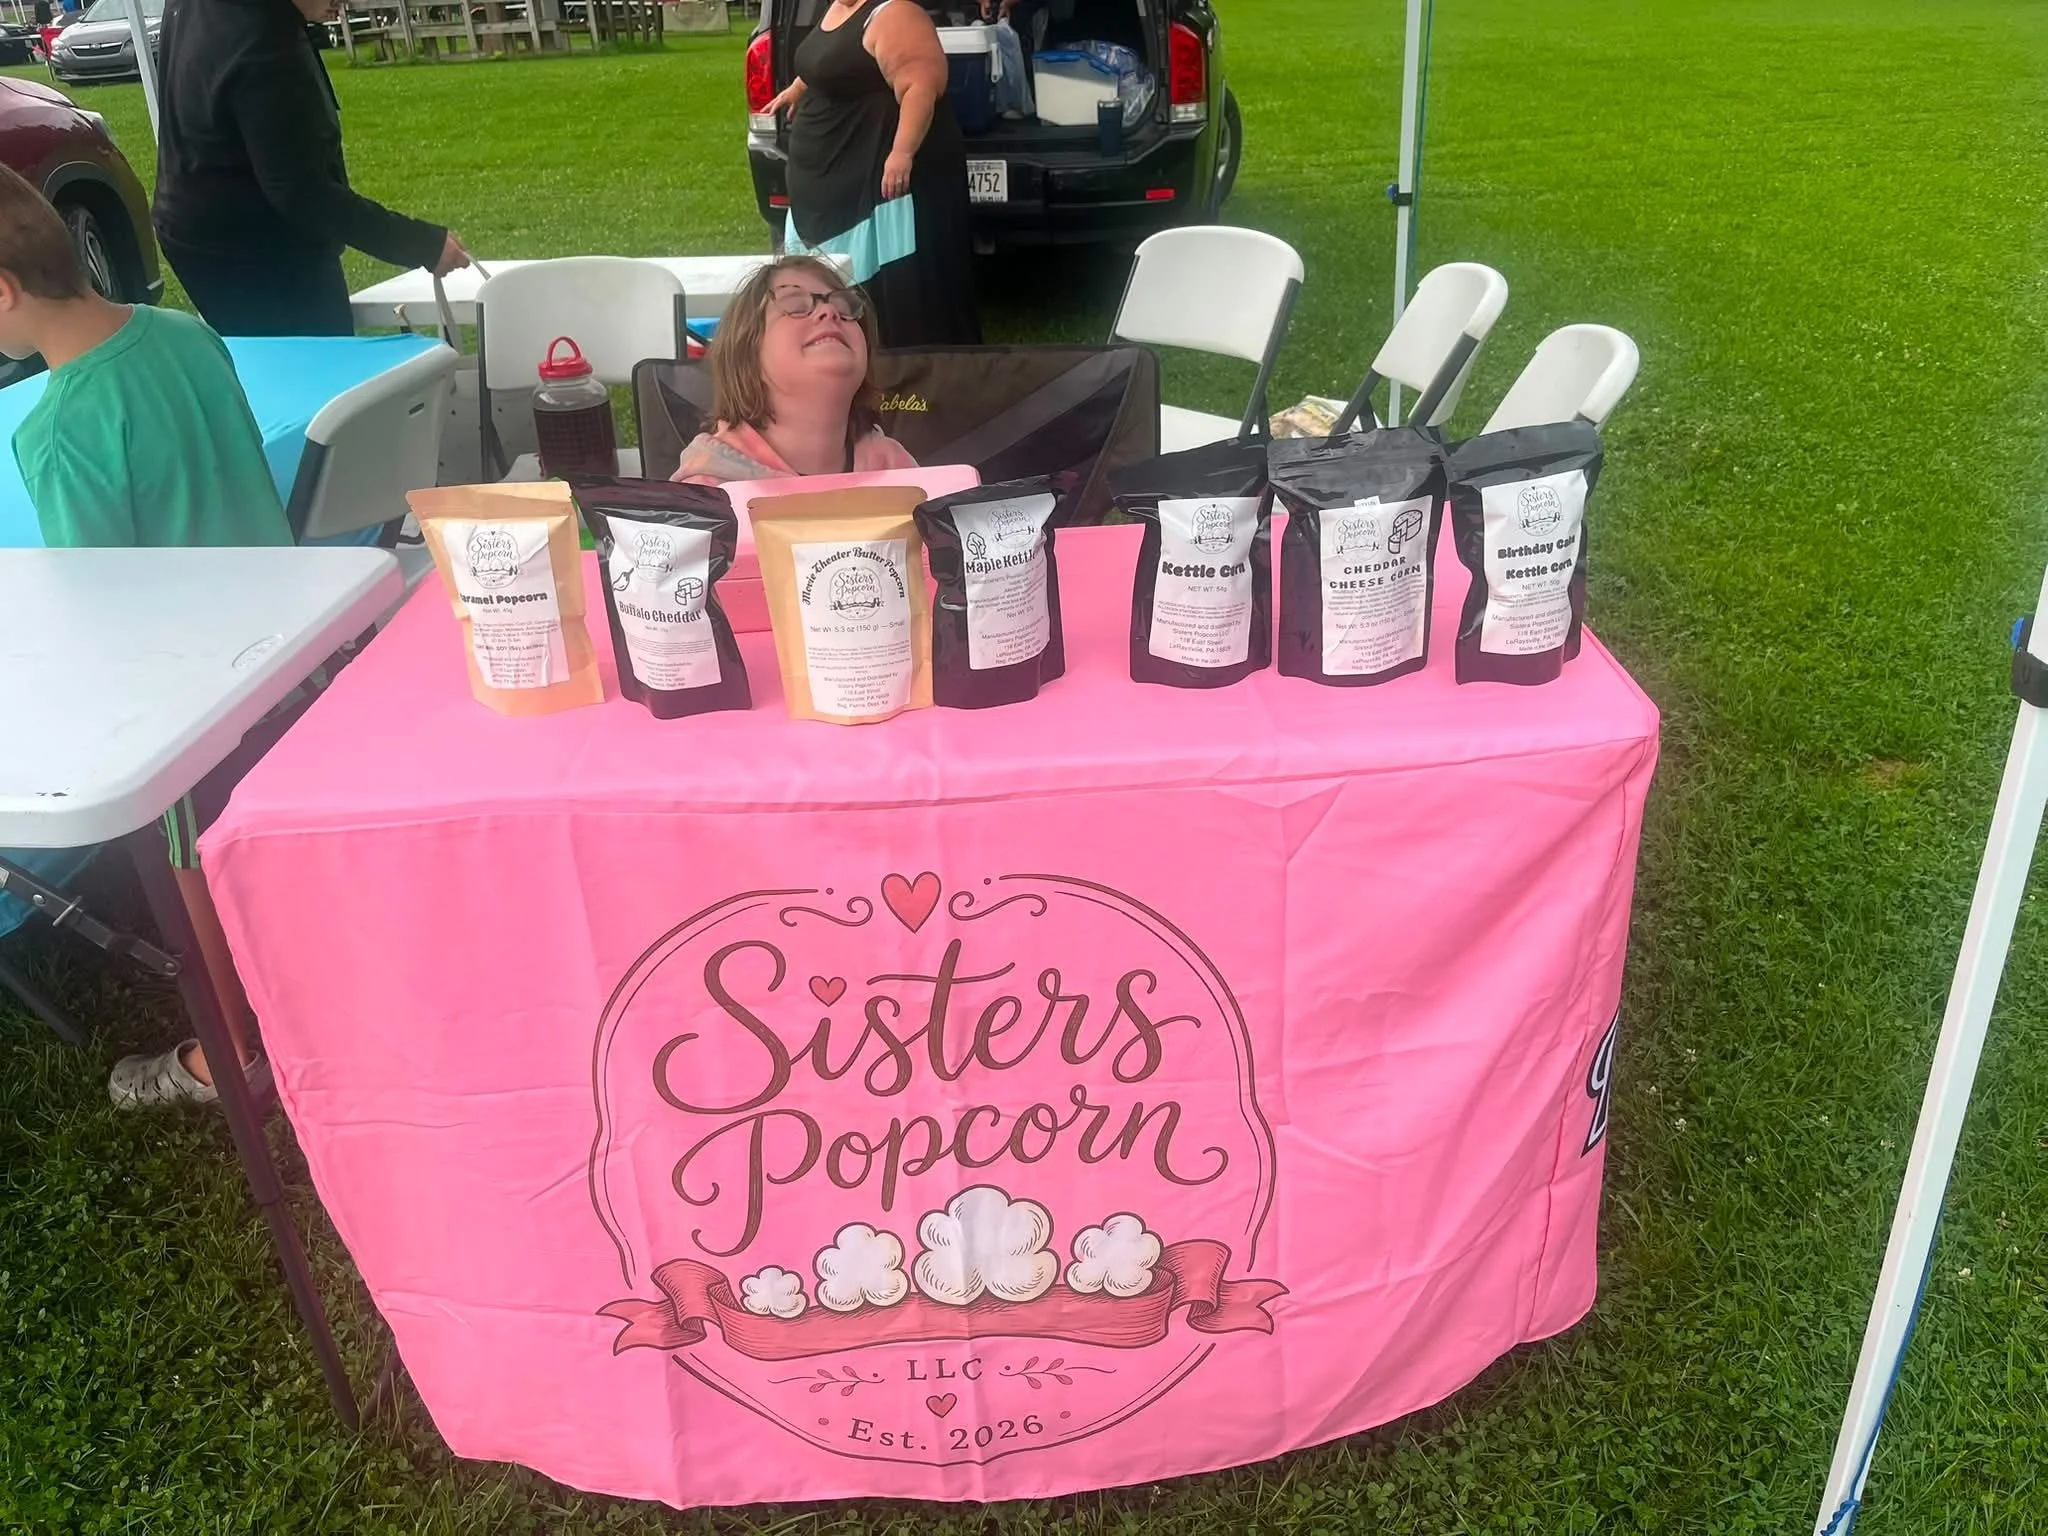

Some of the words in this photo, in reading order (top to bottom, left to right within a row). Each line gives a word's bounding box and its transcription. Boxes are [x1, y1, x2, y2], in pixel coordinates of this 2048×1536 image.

[879, 393, 926, 411] abela's
[1520, 490, 1554, 506] Sisters
[1197, 508, 1231, 521] Sisters
[1523, 500, 1558, 517] Popcorn
[1337, 519, 1374, 533] Sisters
[471, 536, 512, 552] Sisters
[635, 534, 671, 551] Sisters
[1498, 542, 1553, 559] Birthday
[472, 550, 518, 565] Popcorn
[1343, 556, 1407, 575] CHEDDAR
[966, 560, 1002, 574] Maple
[1162, 561, 1216, 578] Kettle
[1506, 566, 1548, 580] Kettle
[1551, 558, 1573, 573] Corn
[802, 573, 817, 606] Movie
[811, 550, 852, 574] Theater
[852, 546, 885, 563] Butter
[883, 558, 906, 599] Popcorn
[834, 571, 875, 588] Sisters
[1329, 577, 1384, 590] CHEESE
[1390, 564, 1421, 582] CORN
[460, 593, 494, 605] aramel
[496, 592, 548, 605] Popcorn
[836, 584, 879, 600] Popcorn
[619, 600, 651, 620] Buffalo
[652, 608, 702, 623] Cheddar
[652, 939, 1201, 1115] Sisters
[672, 1084, 1229, 1257] Popcorn
[907, 1358, 983, 1382] LLC
[847, 1417, 928, 1451] Est.
[949, 1414, 1045, 1452] 2026
